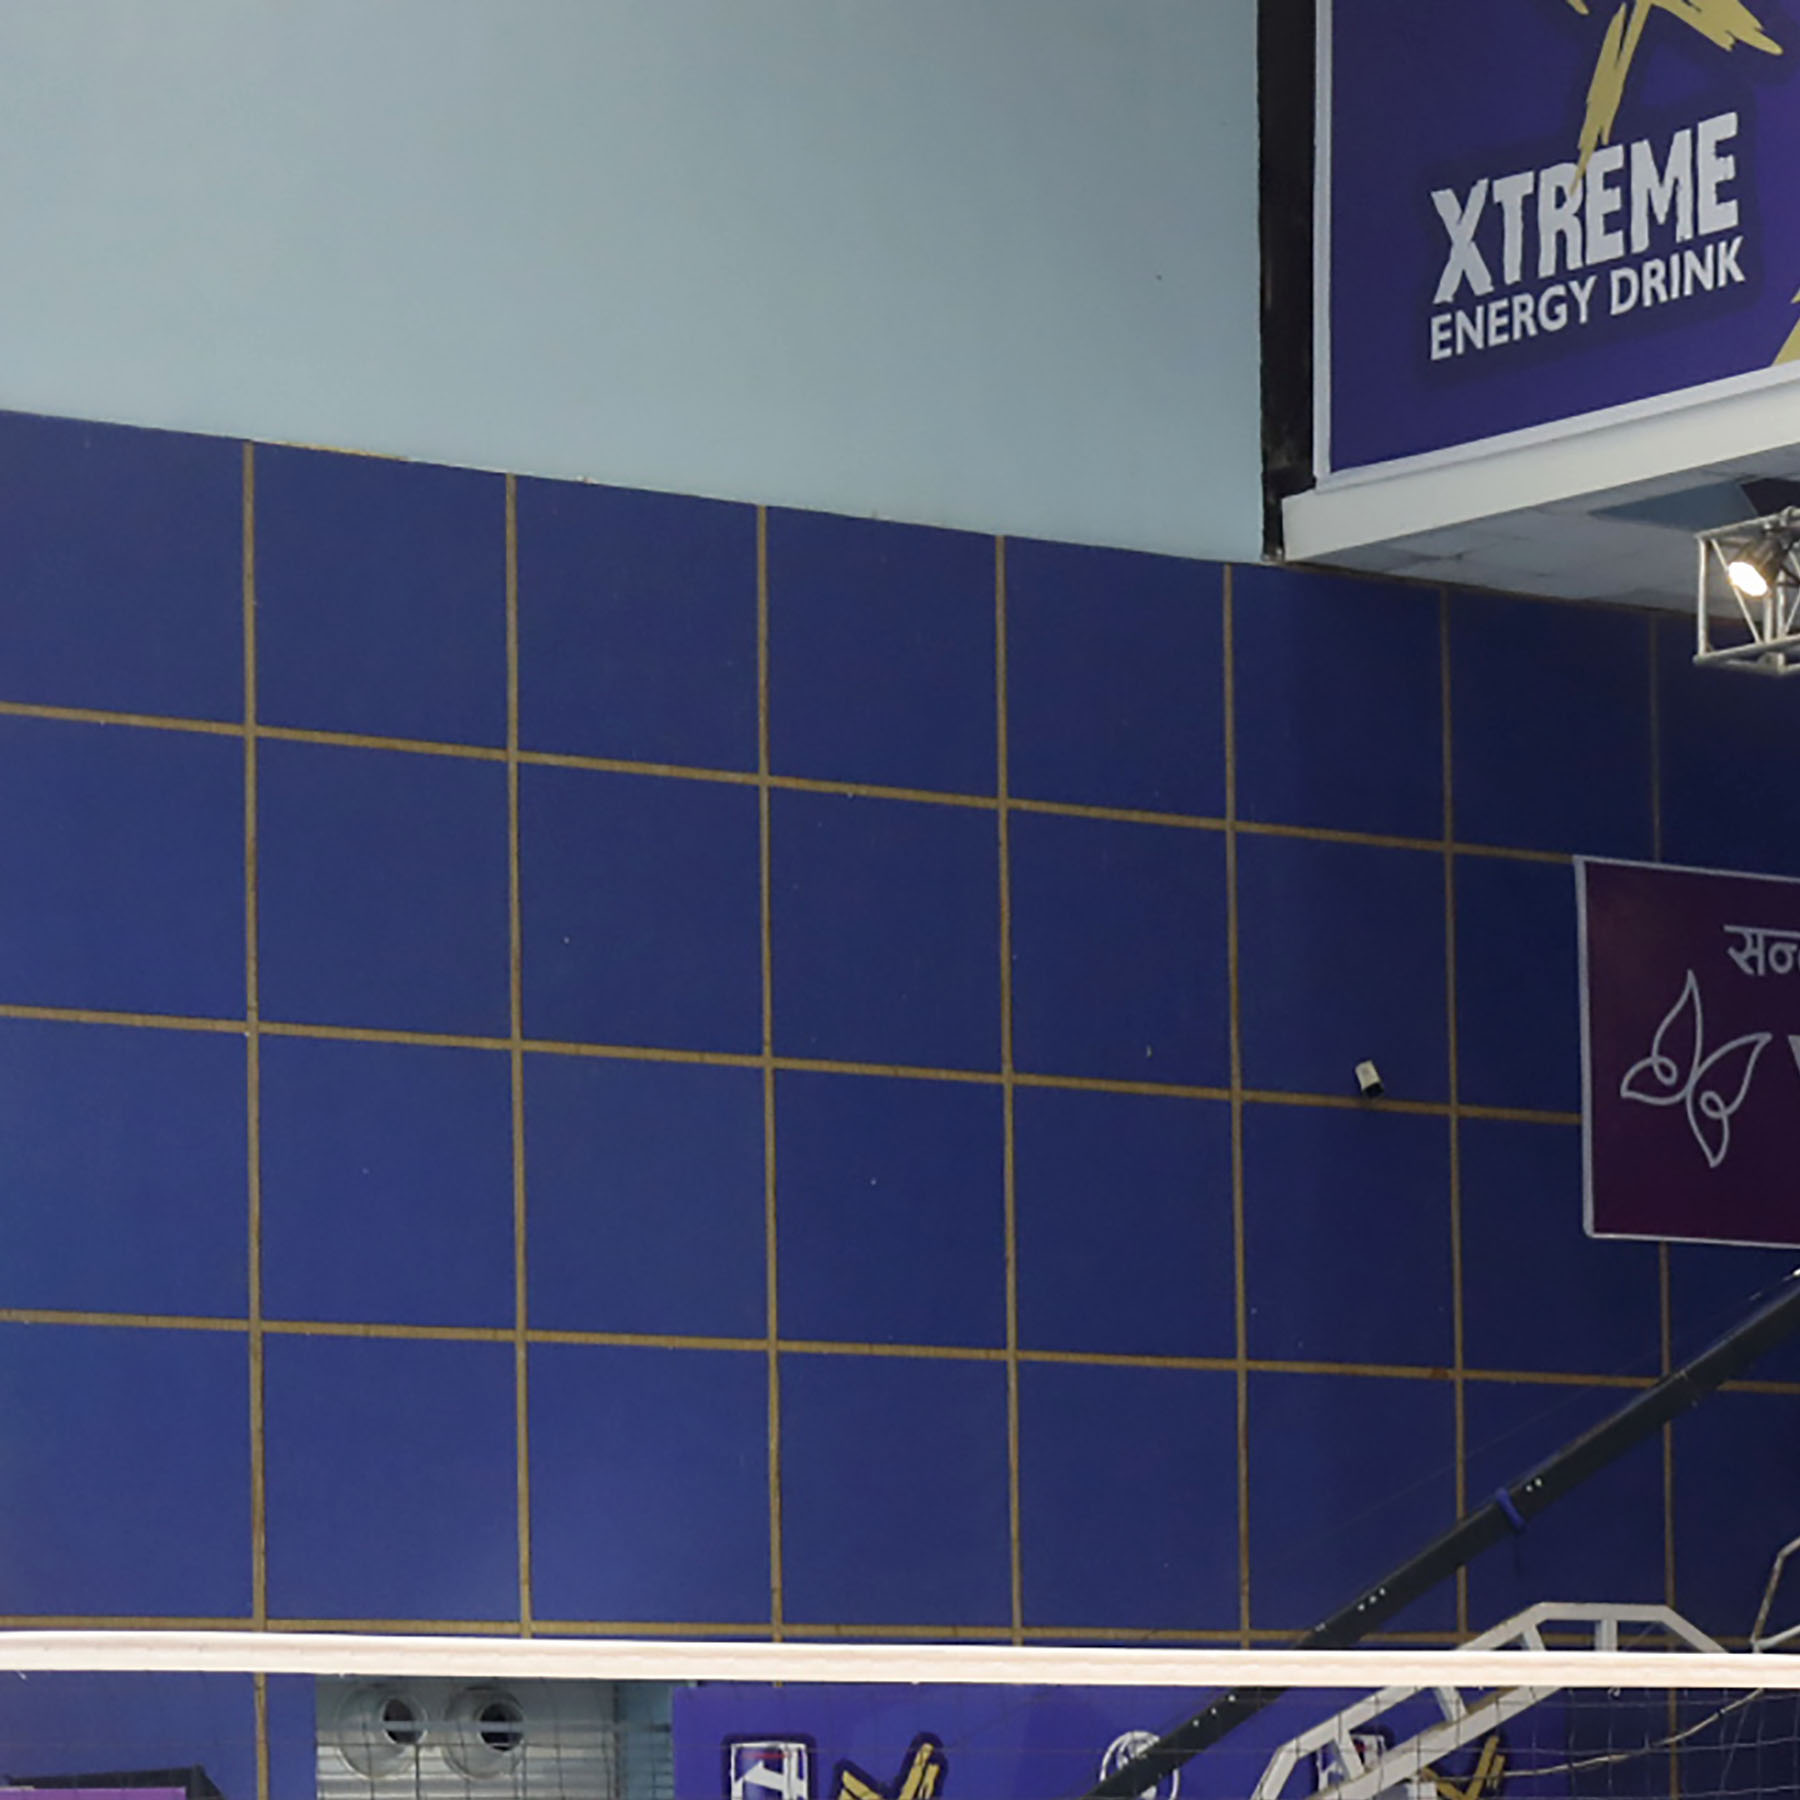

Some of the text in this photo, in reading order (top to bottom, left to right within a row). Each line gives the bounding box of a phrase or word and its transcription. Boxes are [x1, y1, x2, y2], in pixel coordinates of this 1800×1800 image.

[1431, 112, 1738, 304] XTREME
[1430, 236, 1746, 360] ENERGY DRINK
